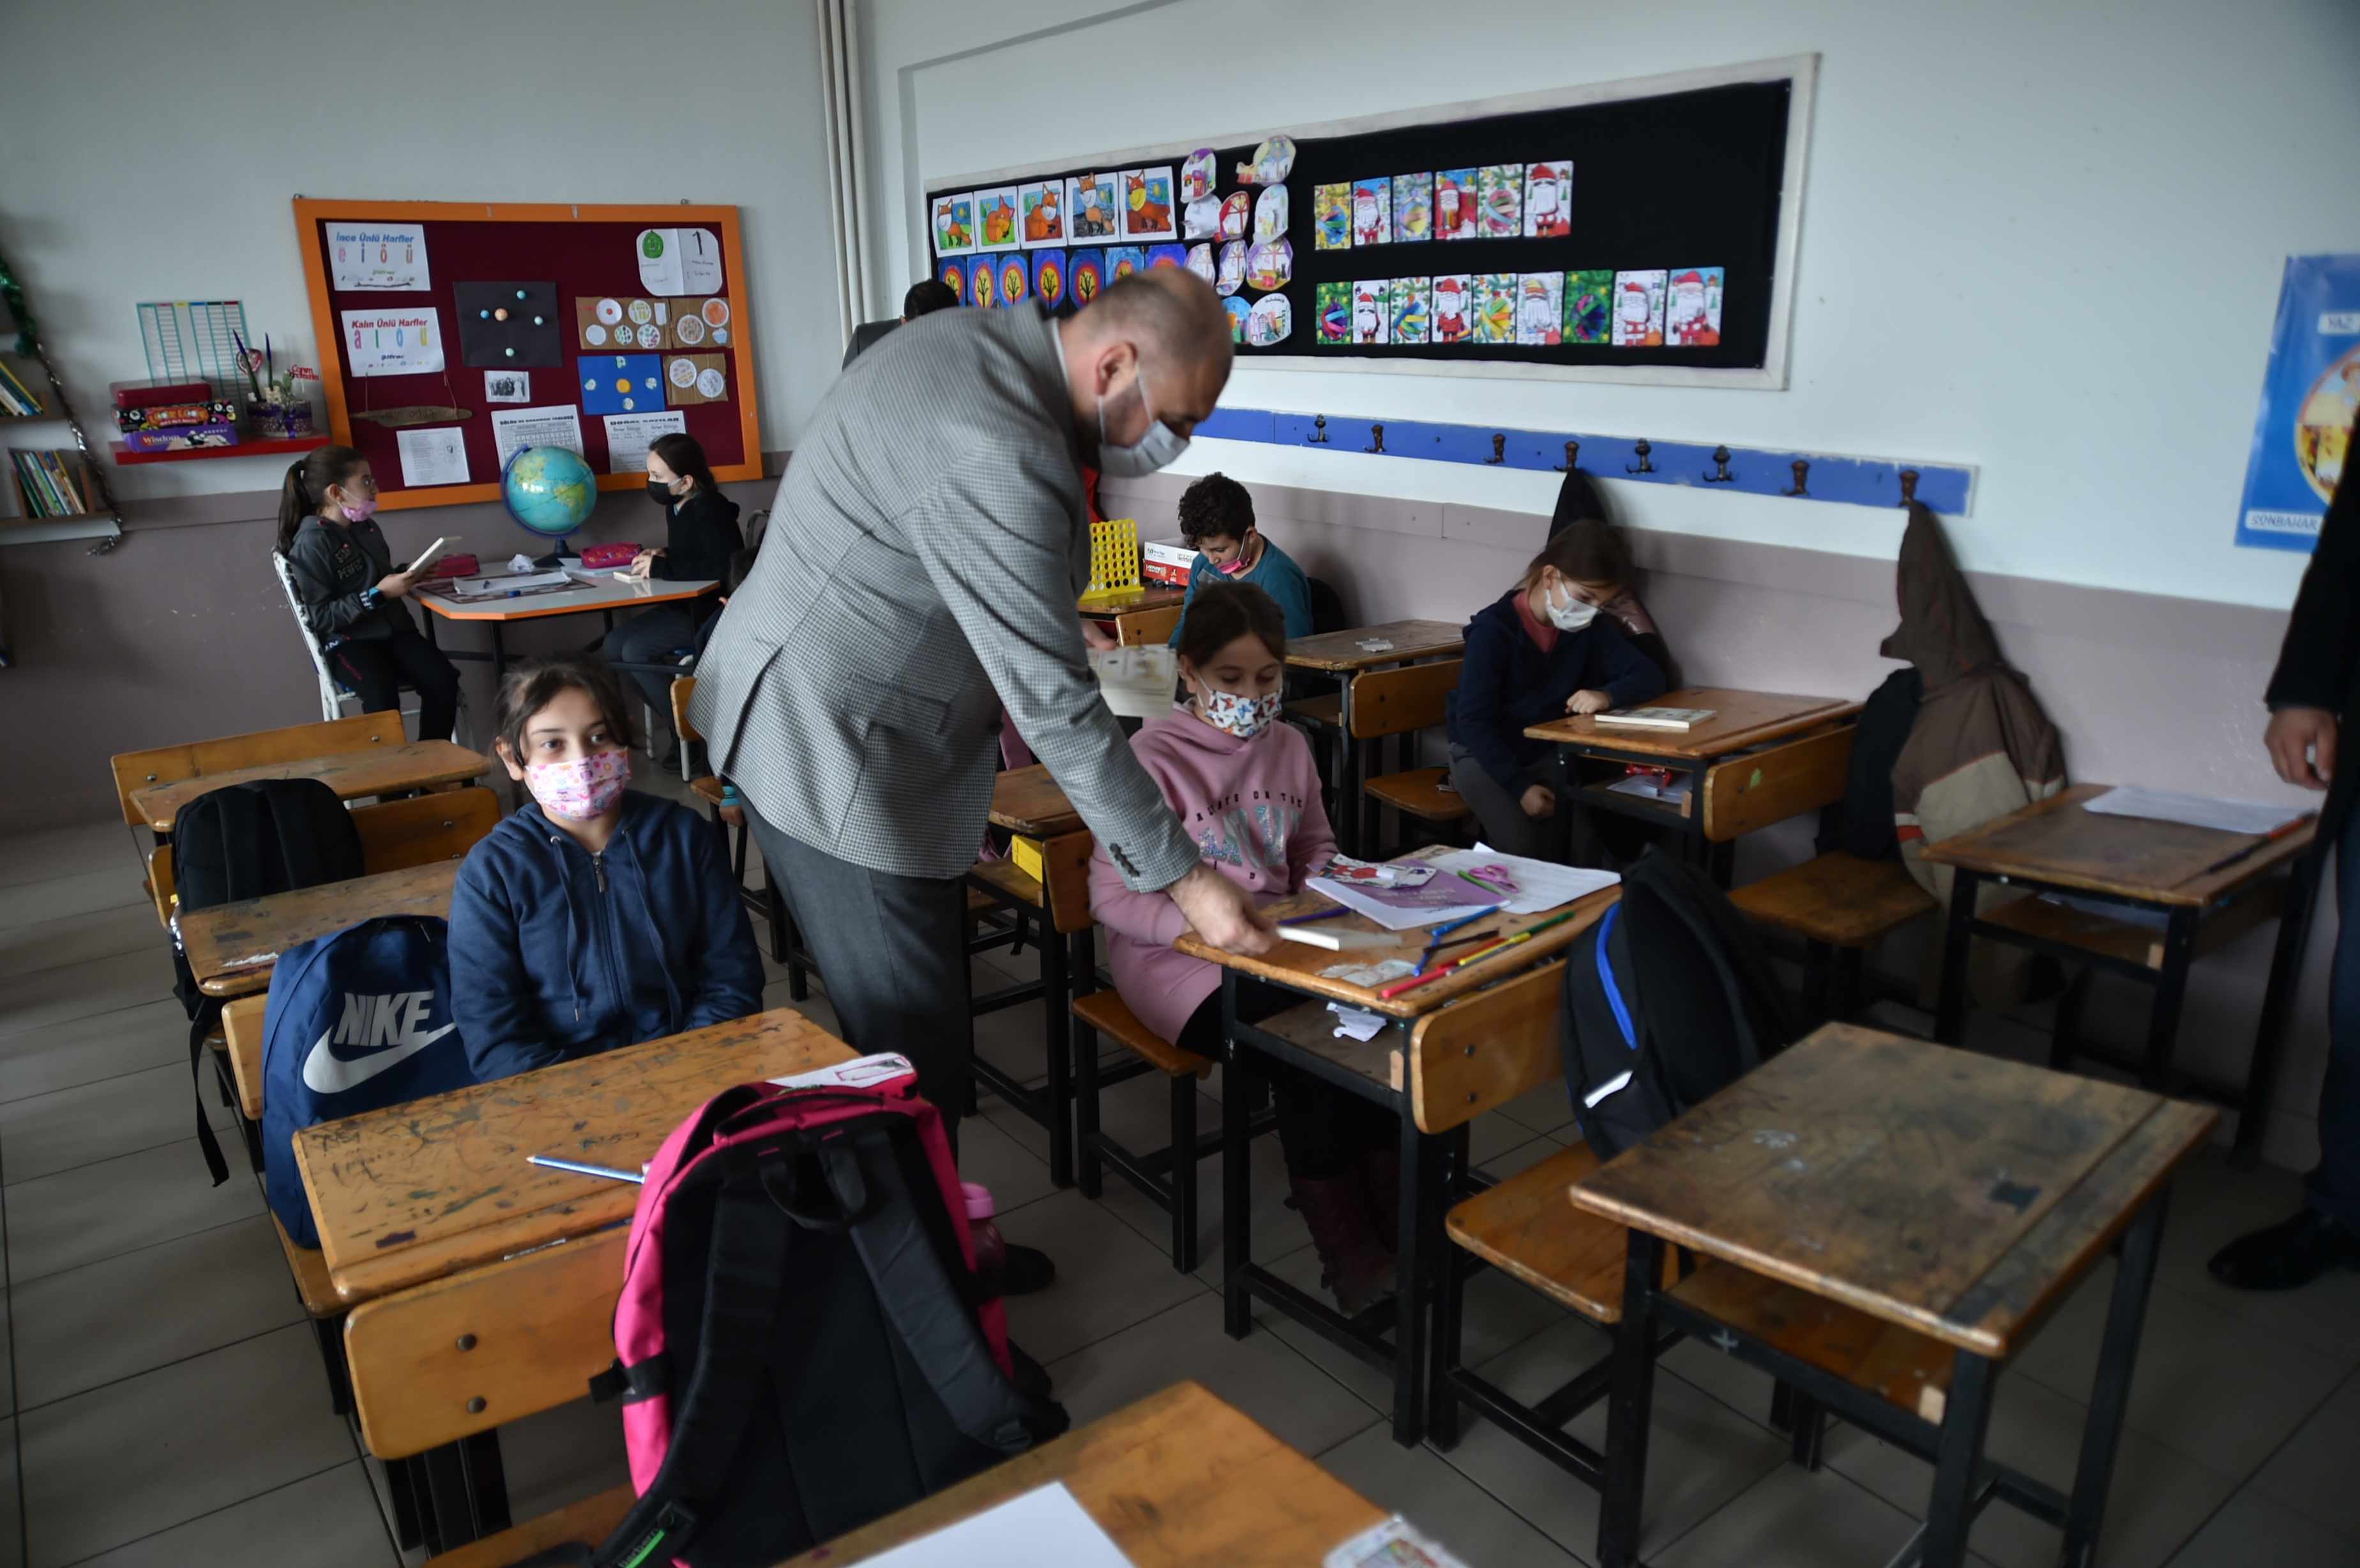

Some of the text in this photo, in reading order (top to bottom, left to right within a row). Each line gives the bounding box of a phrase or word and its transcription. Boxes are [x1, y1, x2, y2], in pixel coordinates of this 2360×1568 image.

[337, 231, 414, 243] İnce Ünlü Harfler
[338, 248, 346, 264] e
[352, 318, 428, 328] Kalın Ünlü Harfler
[2327, 316, 2353, 330] YAZ
[354, 329, 362, 349] a
[396, 328, 404, 348] o
[142, 433, 181, 444] Wisdom
[2251, 515, 2318, 531] SONBAHAR
[333, 990, 435, 1047] NIKE
